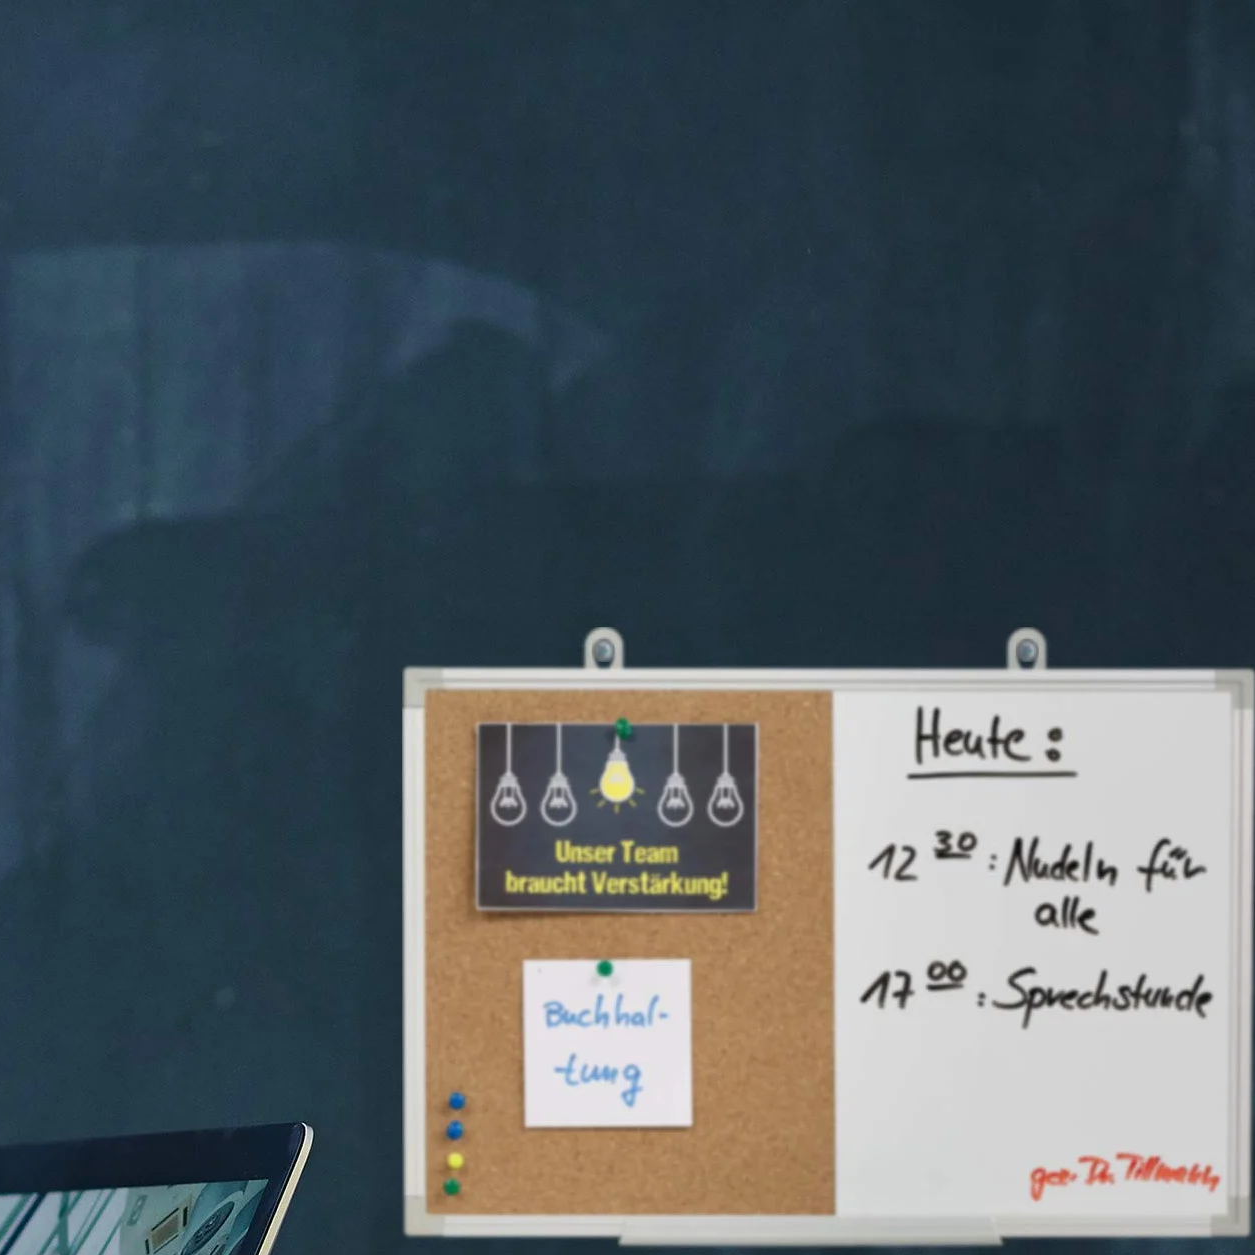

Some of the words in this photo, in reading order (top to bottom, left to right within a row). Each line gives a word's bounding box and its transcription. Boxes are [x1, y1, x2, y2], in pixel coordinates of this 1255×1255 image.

[555, 840, 615, 864] Unser
[621, 840, 679, 864] Team
[1002, 836, 1118, 887] Nudeln
[1136, 837, 1207, 893] für
[505, 870, 586, 894] braucht
[592, 871, 729, 900] Verstärkung!
[1034, 895, 1100, 936] alle
[992, 965, 1214, 1030] Sprechstunde
[553, 1053, 643, 1108] tung
